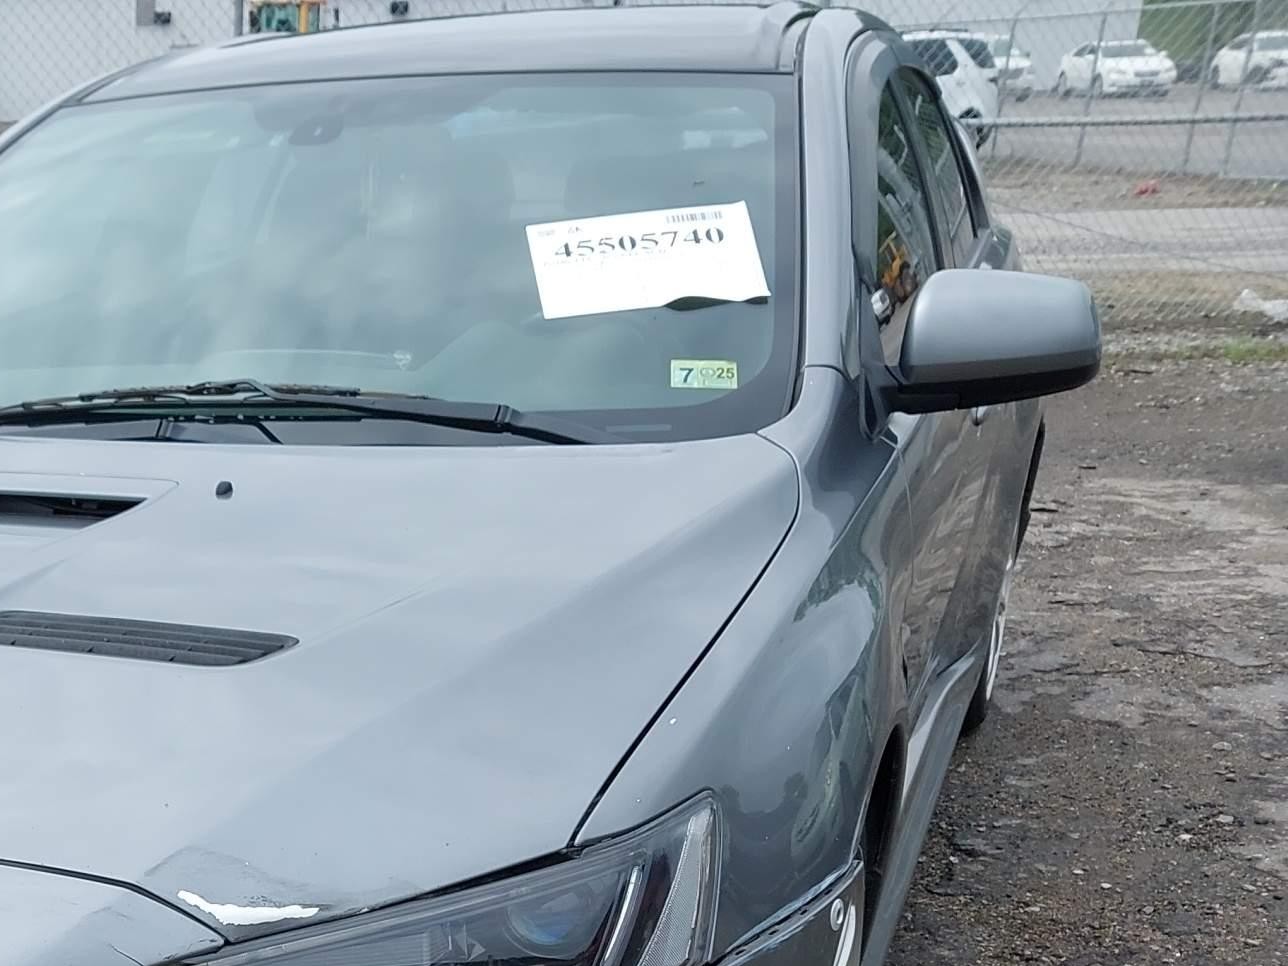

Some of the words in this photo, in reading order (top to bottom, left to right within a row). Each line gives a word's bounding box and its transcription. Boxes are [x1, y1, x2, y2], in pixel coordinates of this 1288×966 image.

[553, 225, 725, 259] 45505740
[679, 367, 694, 383] 7
[716, 367, 735, 380] 25
